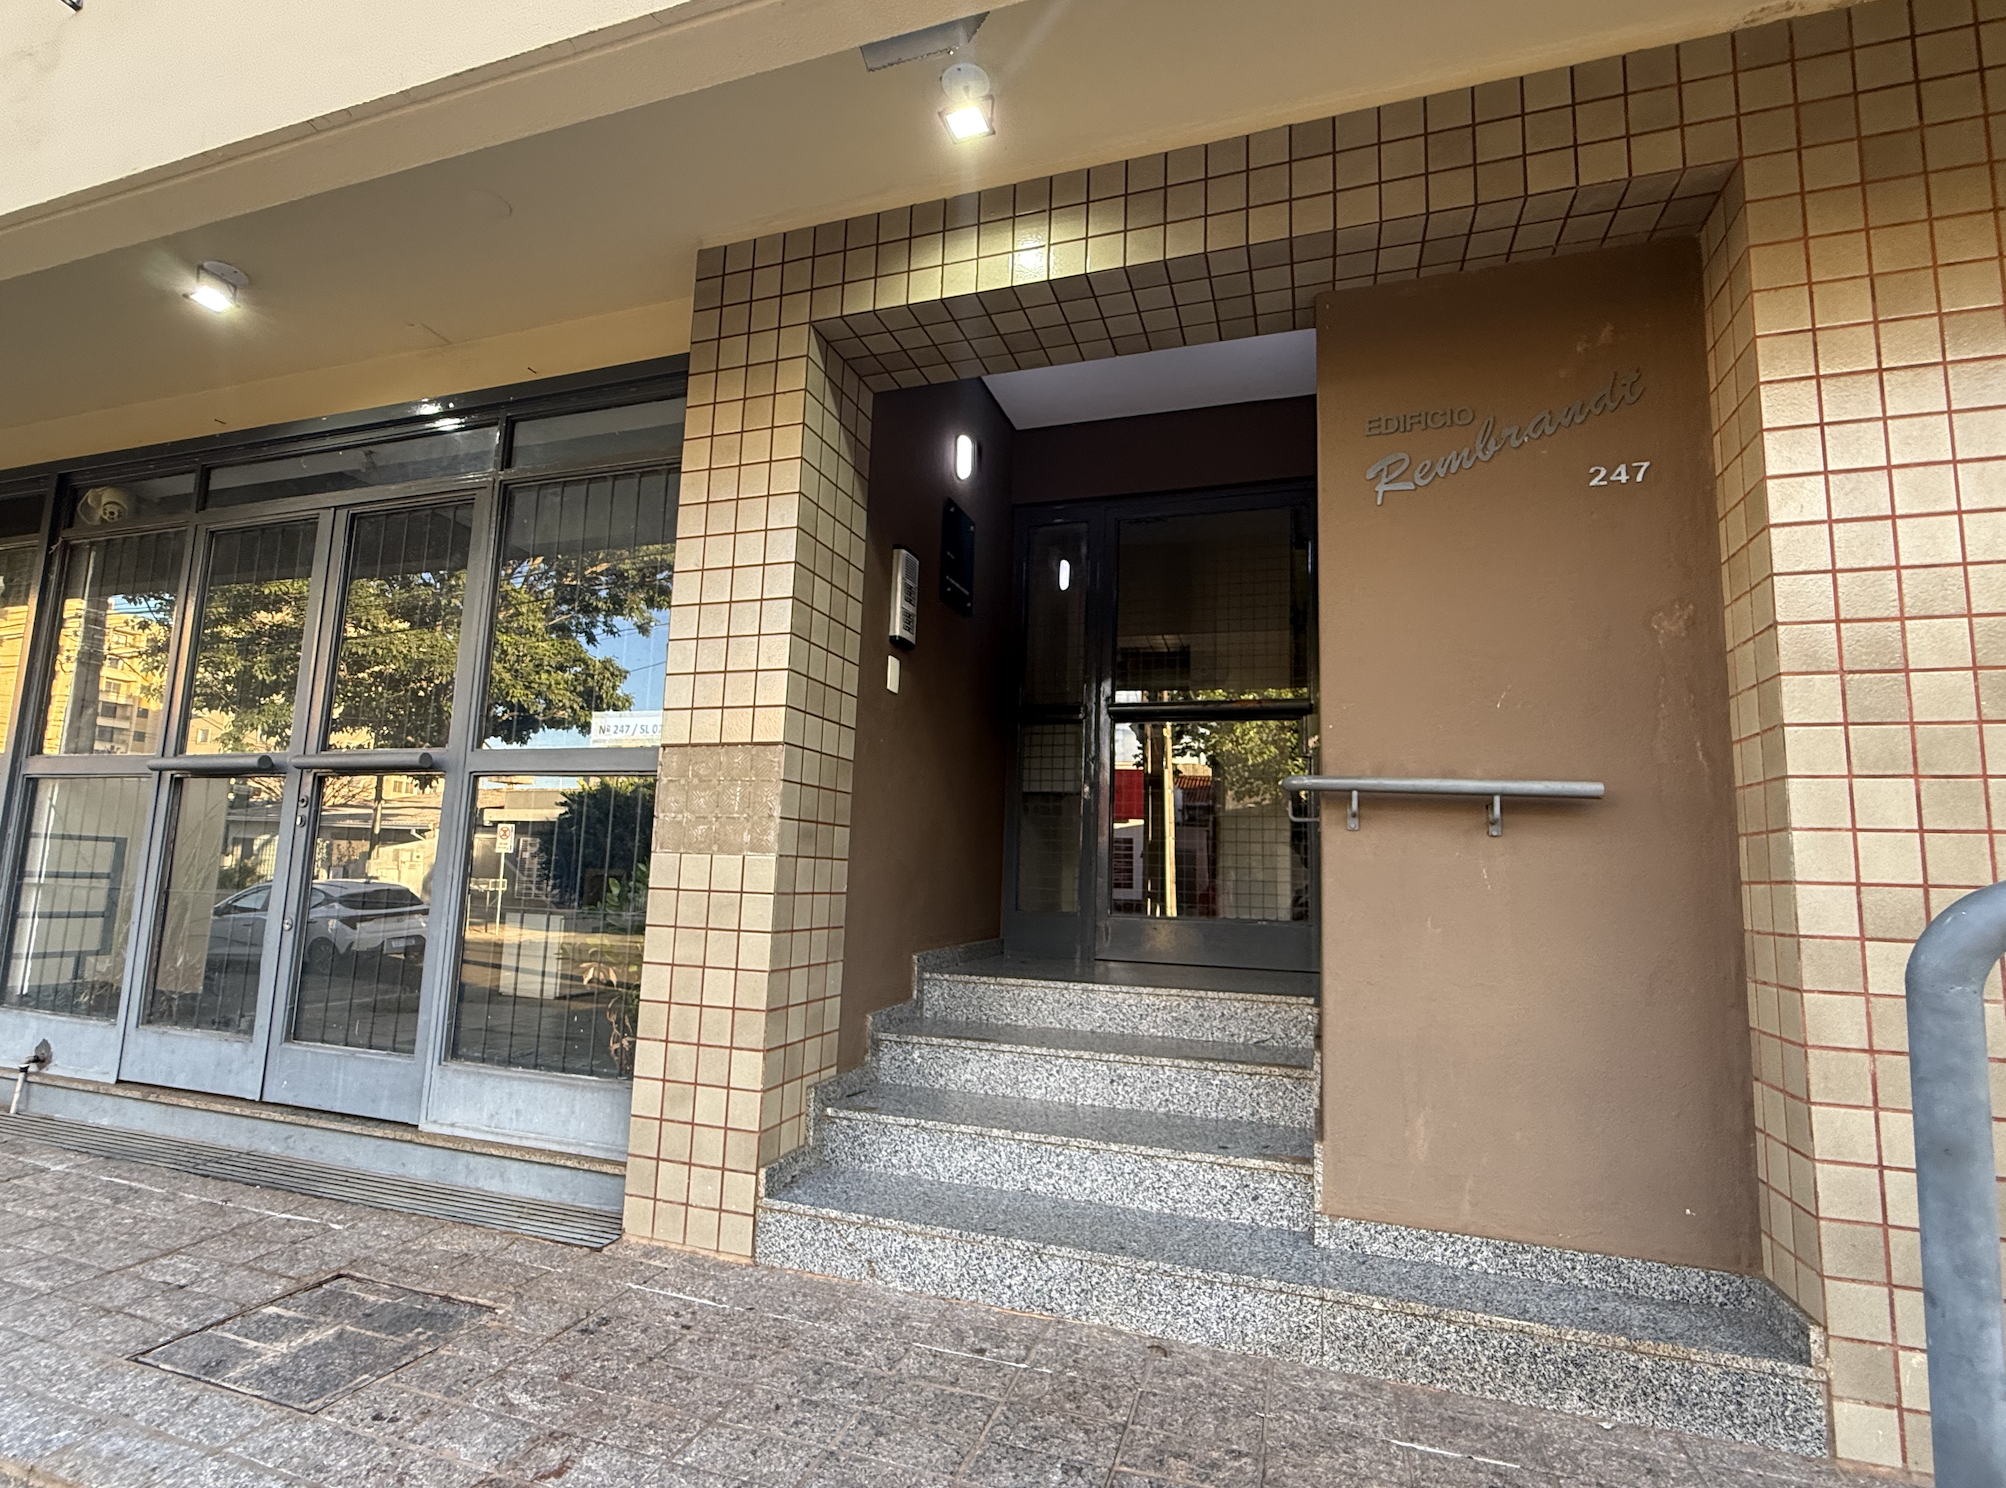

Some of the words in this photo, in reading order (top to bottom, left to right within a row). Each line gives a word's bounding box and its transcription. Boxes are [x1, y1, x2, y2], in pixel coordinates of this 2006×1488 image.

[1365, 406, 1475, 436] EDIFICIO
[1365, 366, 1645, 506] Rembrandt
[1589, 461, 1651, 487] 247
[613, 724, 630, 735] 247
[639, 724, 650, 734] SL
